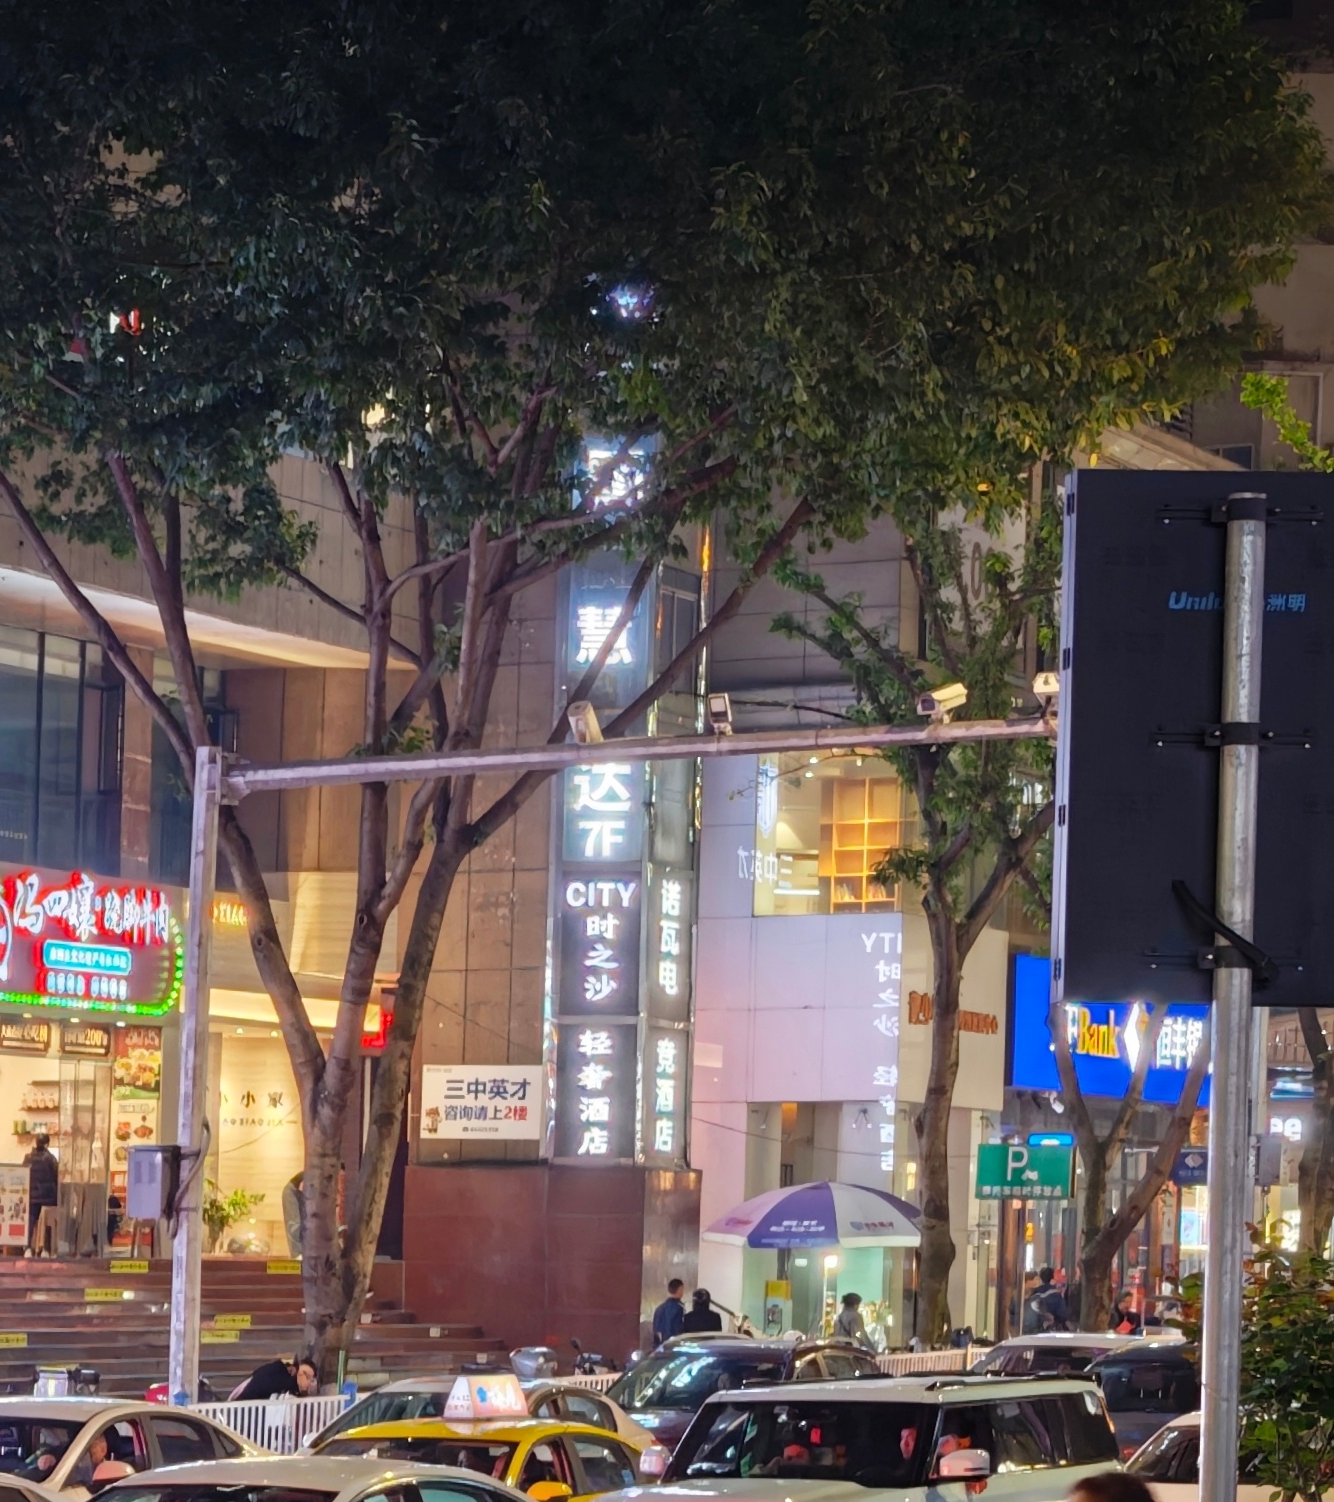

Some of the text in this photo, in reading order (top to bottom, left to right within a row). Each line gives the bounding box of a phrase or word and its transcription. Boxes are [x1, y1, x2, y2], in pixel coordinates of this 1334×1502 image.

[579, 820, 626, 857] 7F
[565, 881, 637, 908] CITY
[583, 914, 620, 1001] 时之沙
[444, 1077, 531, 1101] 三中英才
[1007, 1146, 1028, 1181] P
